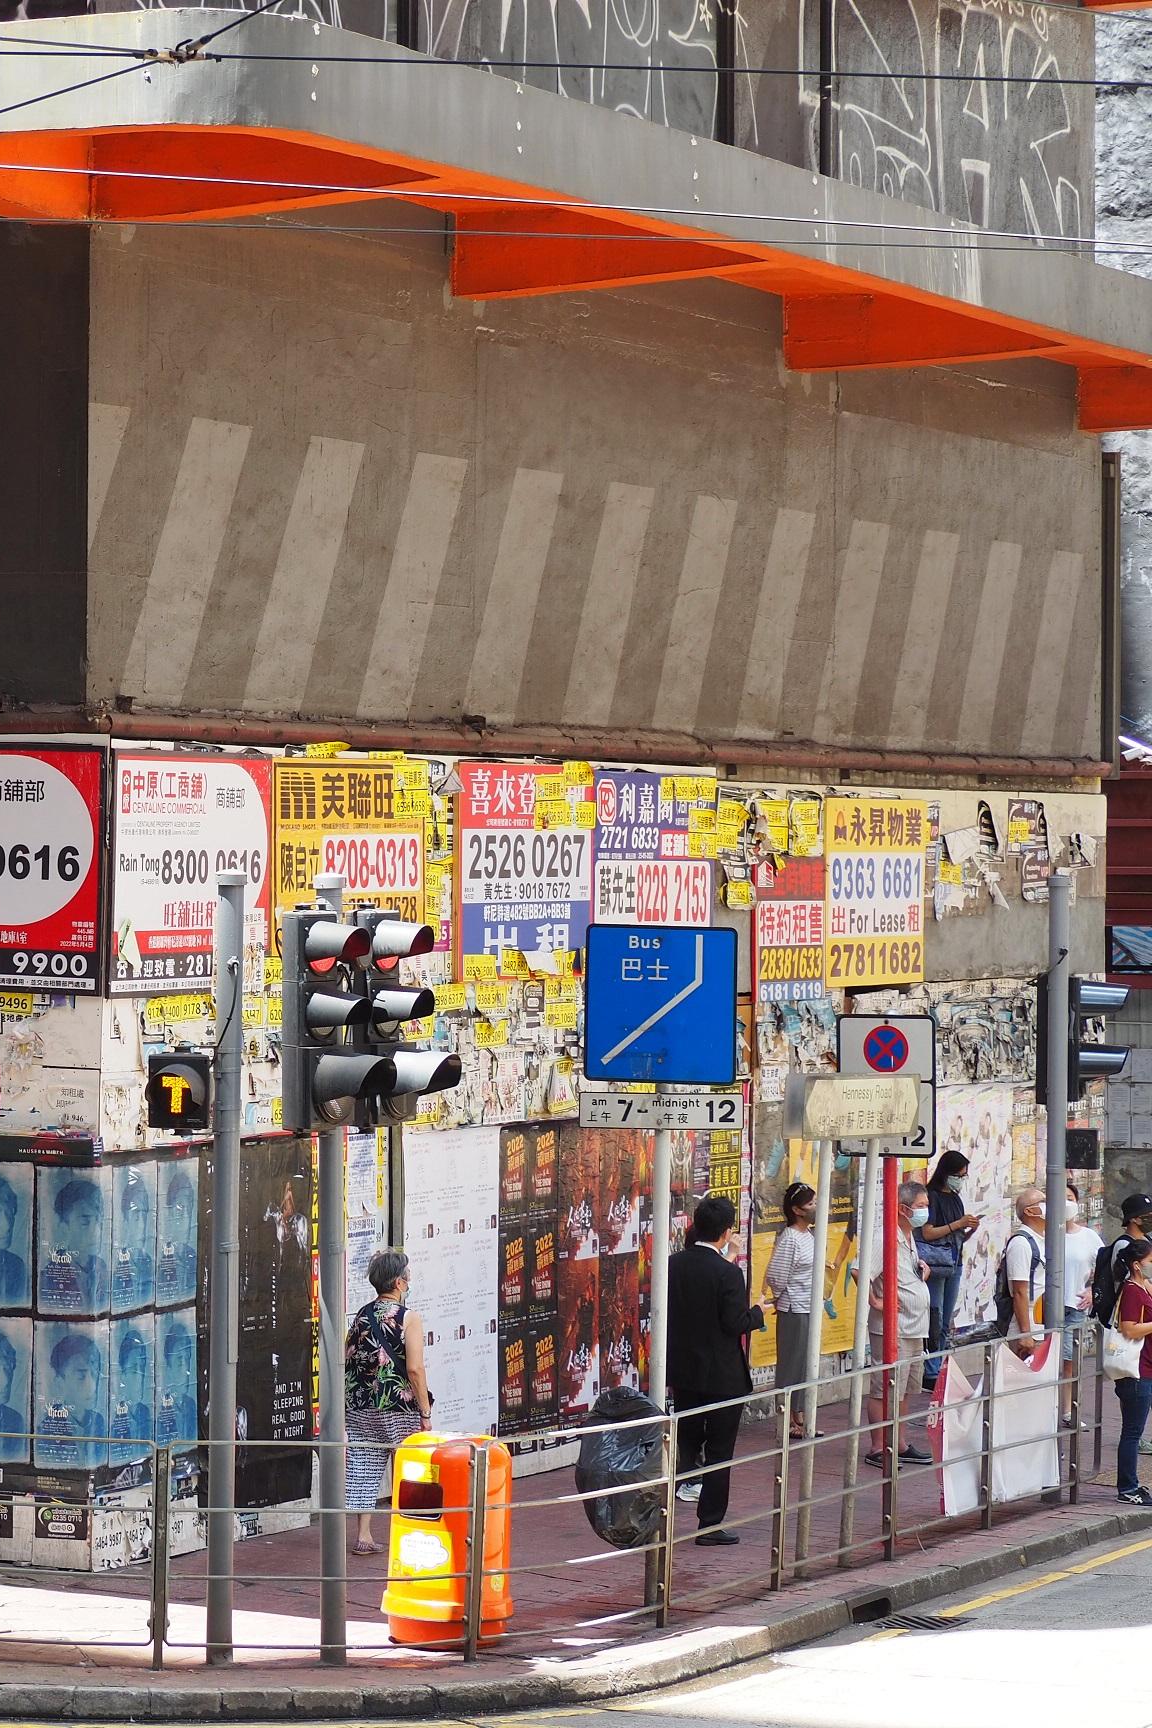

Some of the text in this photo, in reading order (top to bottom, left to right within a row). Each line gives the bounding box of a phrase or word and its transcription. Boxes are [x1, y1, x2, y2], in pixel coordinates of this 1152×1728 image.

[133, 802, 207, 814] CENTALINE COMMERCIAL
[600, 826, 659, 849] 2721 6833
[850, 807, 922, 846] 永昇物業
[120, 852, 159, 875] Rain Tong
[162, 850, 208, 884] 8300
[326, 839, 418, 888] 8208-0313
[469, 834, 585, 879] 2526 0267
[832, 858, 875, 899] 9363
[883, 858, 921, 899] 6681
[519, 883, 571, 899] 9018 7672
[637, 865, 667, 922] 8228
[675, 865, 706, 922] 2153
[760, 904, 822, 945] 特約租售
[832, 904, 920, 934] 出 For Lease 租
[628, 936, 661, 950] Bus
[12, 952, 88, 976] 9900
[621, 958, 670, 982] 巴士
[760, 948, 822, 980] 28381633
[830, 942, 921, 977] 27811682
[760, 981, 821, 1001] 6181 6119
[842, 1085, 893, 1101] Hennessy Road
[586, 1111, 689, 1124] 上午 午夜
[592, 1097, 736, 1123] am midnight 12
[275, 1381, 302, 1395] AND I'M
[273, 1395, 304, 1410] SLEEPING
[272, 1410, 306, 1425] REAL GOOD
[274, 1425, 304, 1440] AT NIGHT
